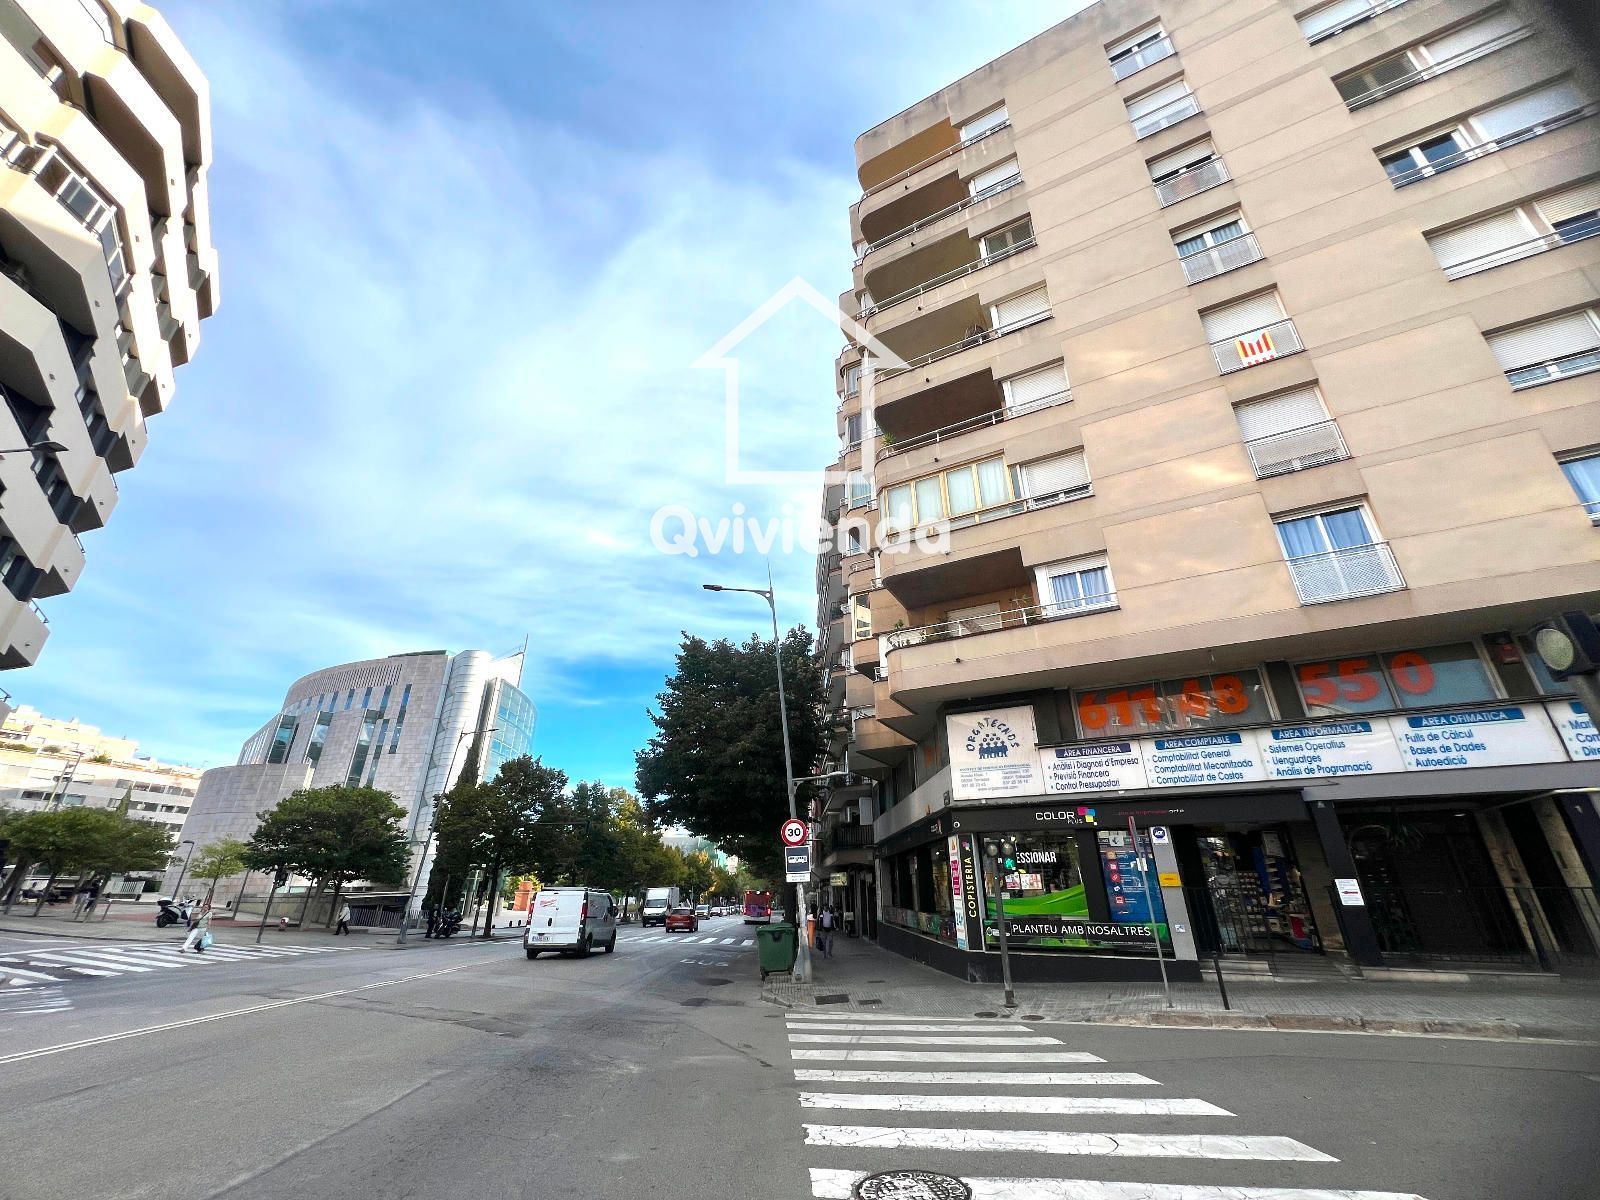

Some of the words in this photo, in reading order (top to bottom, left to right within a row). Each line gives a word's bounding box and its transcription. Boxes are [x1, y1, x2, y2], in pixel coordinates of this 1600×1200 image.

[966, 717, 1020, 751] ORGATECNOS
[1405, 733, 1426, 743] Fulls
[1427, 732, 1440, 742] de
[1441, 729, 1474, 740] Càlcul
[1184, 735, 1231, 747] COMPTABLE
[1269, 744, 1304, 754] Sistemes
[1304, 740, 1346, 752] Operatius
[1082, 745, 1122, 756] FINANCERA
[1409, 745, 1437, 755] Bases
[1439, 744, 1452, 753] de
[1453, 741, 1487, 752] Dades
[1152, 752, 1200, 763] Comptabilitat
[1200, 748, 1231, 759] General
[1415, 755, 1468, 767] Autoedició
[1076, 760, 1104, 770] Diagnosi
[1104, 757, 1139, 767] d'Empresa
[1154, 763, 1202, 774] Comptabilitat
[1203, 759, 1253, 770] Mecanitzada
[1304, 765, 1315, 775] de
[1316, 761, 1373, 775] Programació
[1053, 771, 1077, 780] Previsió
[1077, 770, 1110, 779] Financera
[1156, 774, 1205, 785] Comptabilitat
[1207, 772, 1217, 781] de
[1218, 771, 1244, 781] Costos
[1056, 781, 1078, 791] Control
[1079, 779, 1121, 790] Pressupostari
[1035, 811, 1075, 821] COLOR
[787, 827, 801, 837] 30
[1015, 851, 1057, 864] ESSIONAR
[964, 857, 977, 918] COPISTERIA
[1012, 924, 1058, 934] PLANTEU
[1061, 925, 1085, 935] AMB
[1086, 925, 1151, 937] NOSALTRES
